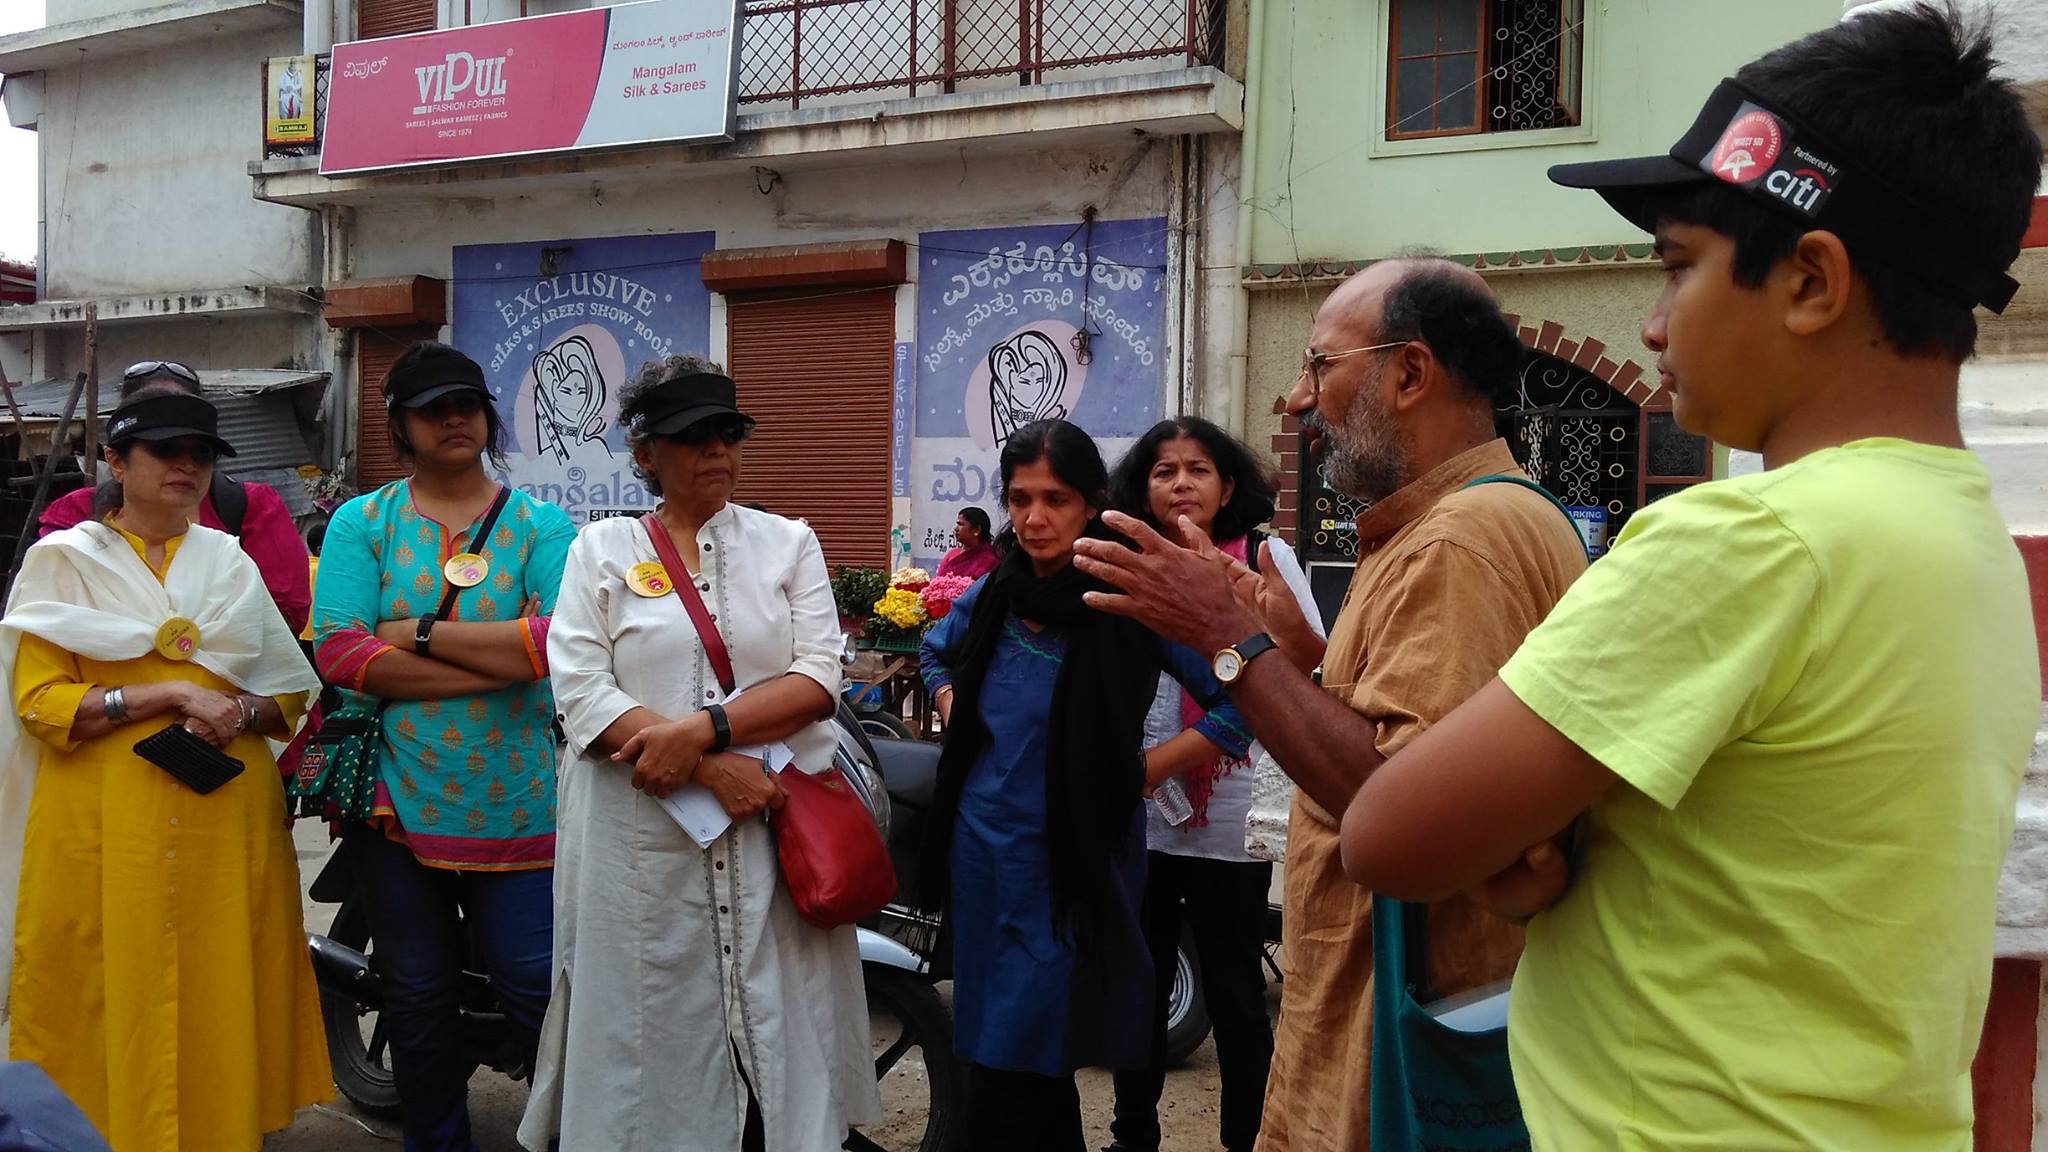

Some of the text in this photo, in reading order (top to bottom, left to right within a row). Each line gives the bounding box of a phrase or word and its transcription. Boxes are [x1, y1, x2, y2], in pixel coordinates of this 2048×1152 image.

[344, 56, 388, 79] ವಿಪುಲ್
[415, 52, 507, 103] VIPUL
[632, 62, 697, 79] Mangalam
[432, 97, 505, 113] FASHION FOREVER
[623, 80, 706, 98] Silk & Sarees
[438, 130, 456, 138] SINCE
[1794, 146, 1838, 176] Partnered by
[1766, 169, 1821, 211] citi
[500, 271, 657, 329] EXCLUSIVE
[490, 302, 673, 373] SILKS & SAREES SHOW ROOM
[896, 345, 907, 403] STICK
[489, 466, 655, 525] angala
